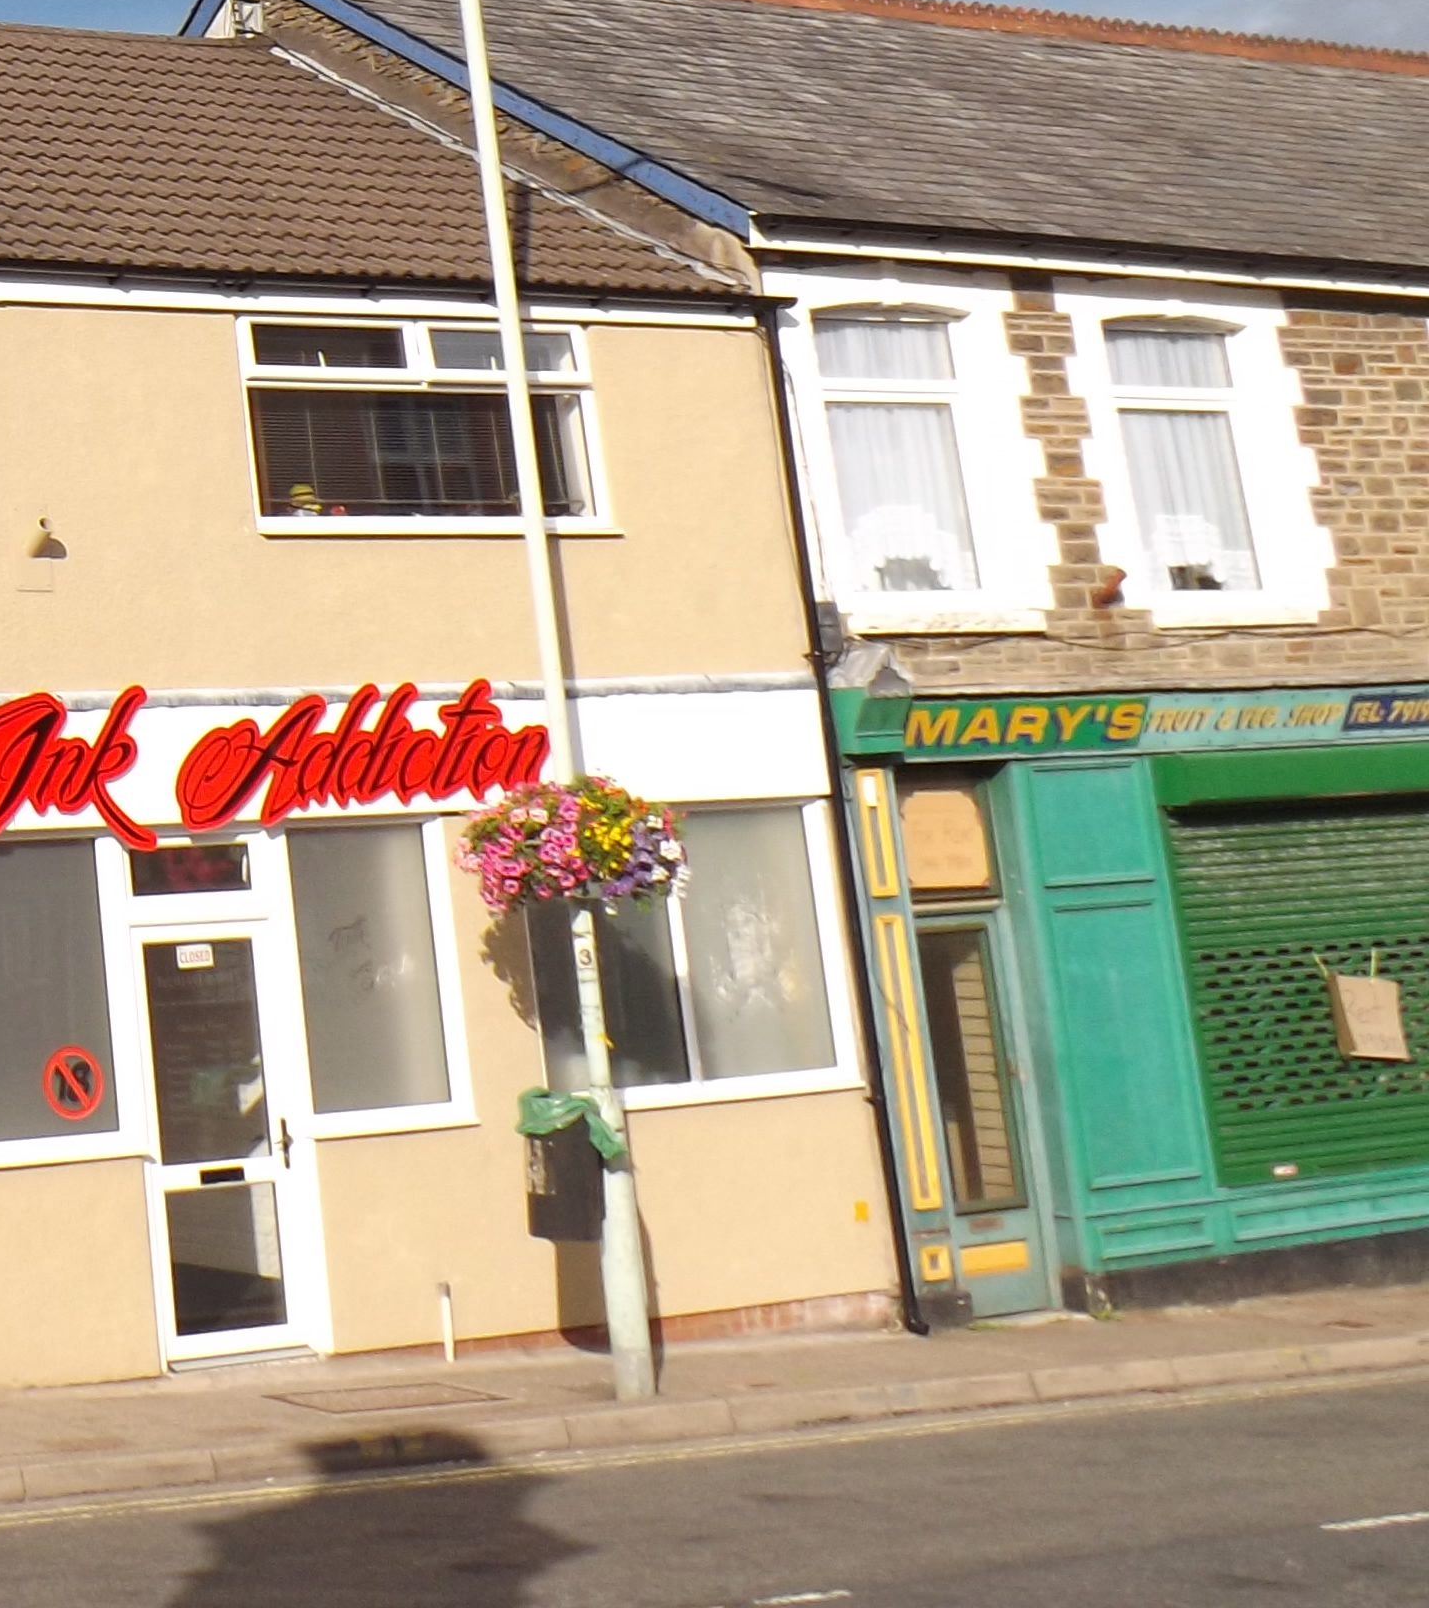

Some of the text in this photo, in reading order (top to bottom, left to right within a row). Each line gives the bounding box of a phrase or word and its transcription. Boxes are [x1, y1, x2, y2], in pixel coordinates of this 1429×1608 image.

[904, 702, 1145, 747] MARY'S
[1145, 707, 1214, 733] FRUIT
[178, 681, 548, 829] Addiction
[179, 950, 211, 965] CLOSED
